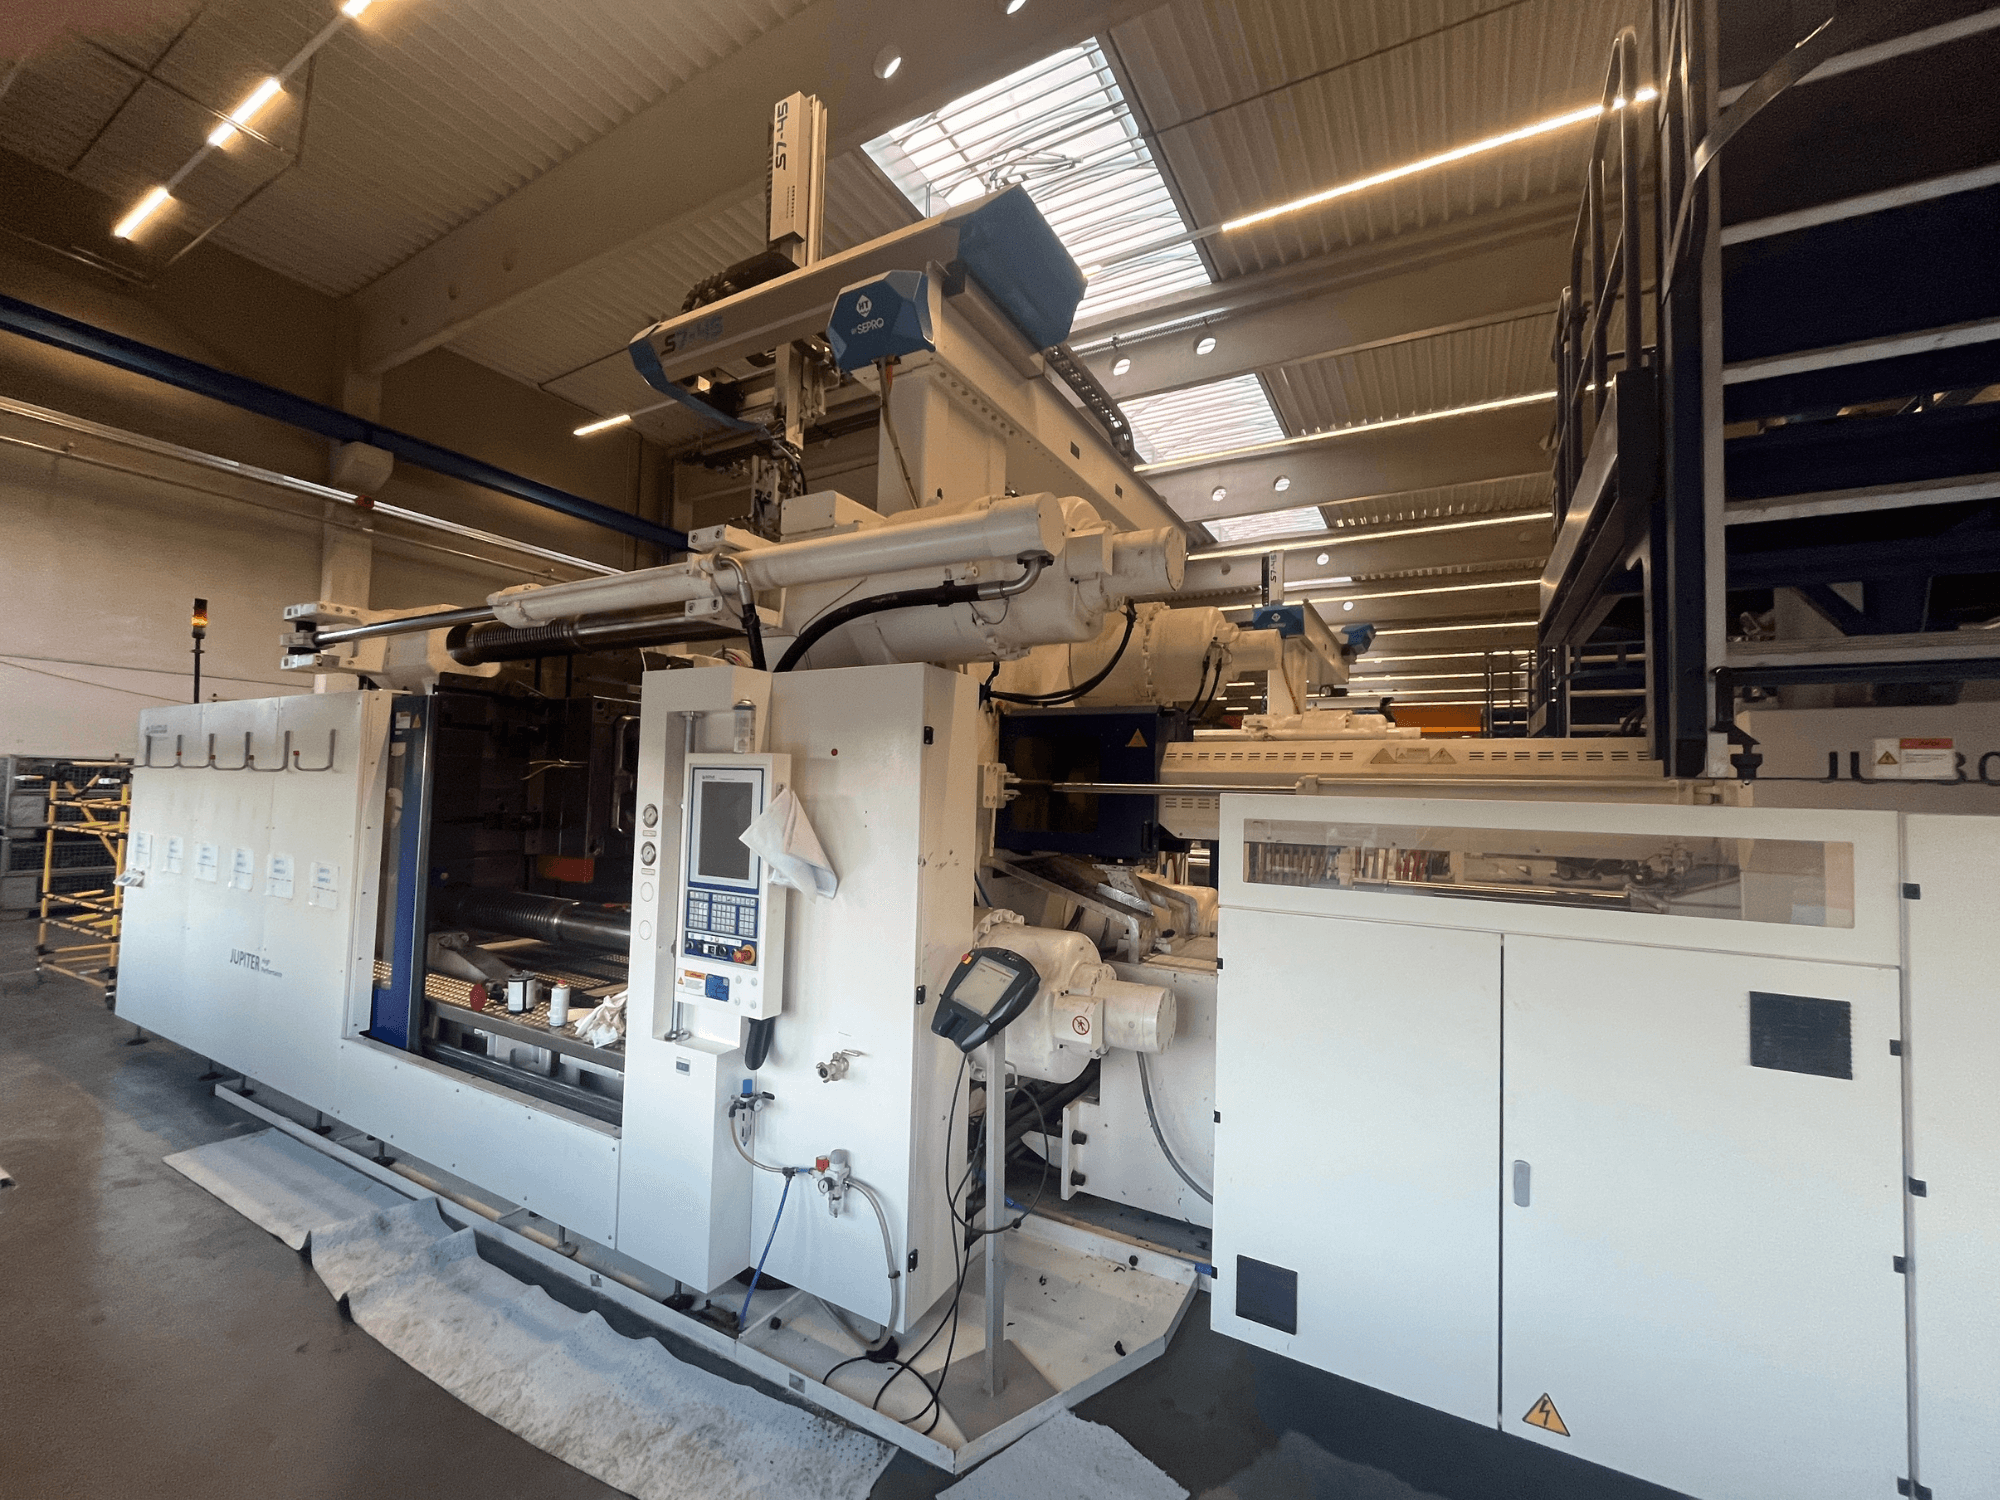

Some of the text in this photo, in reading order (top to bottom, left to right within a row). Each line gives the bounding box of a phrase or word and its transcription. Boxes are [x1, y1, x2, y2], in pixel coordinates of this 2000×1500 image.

[775, 101, 788, 171] S7-45
[857, 317, 884, 334] SEPRO
[230, 948, 260, 971] JUPITER
